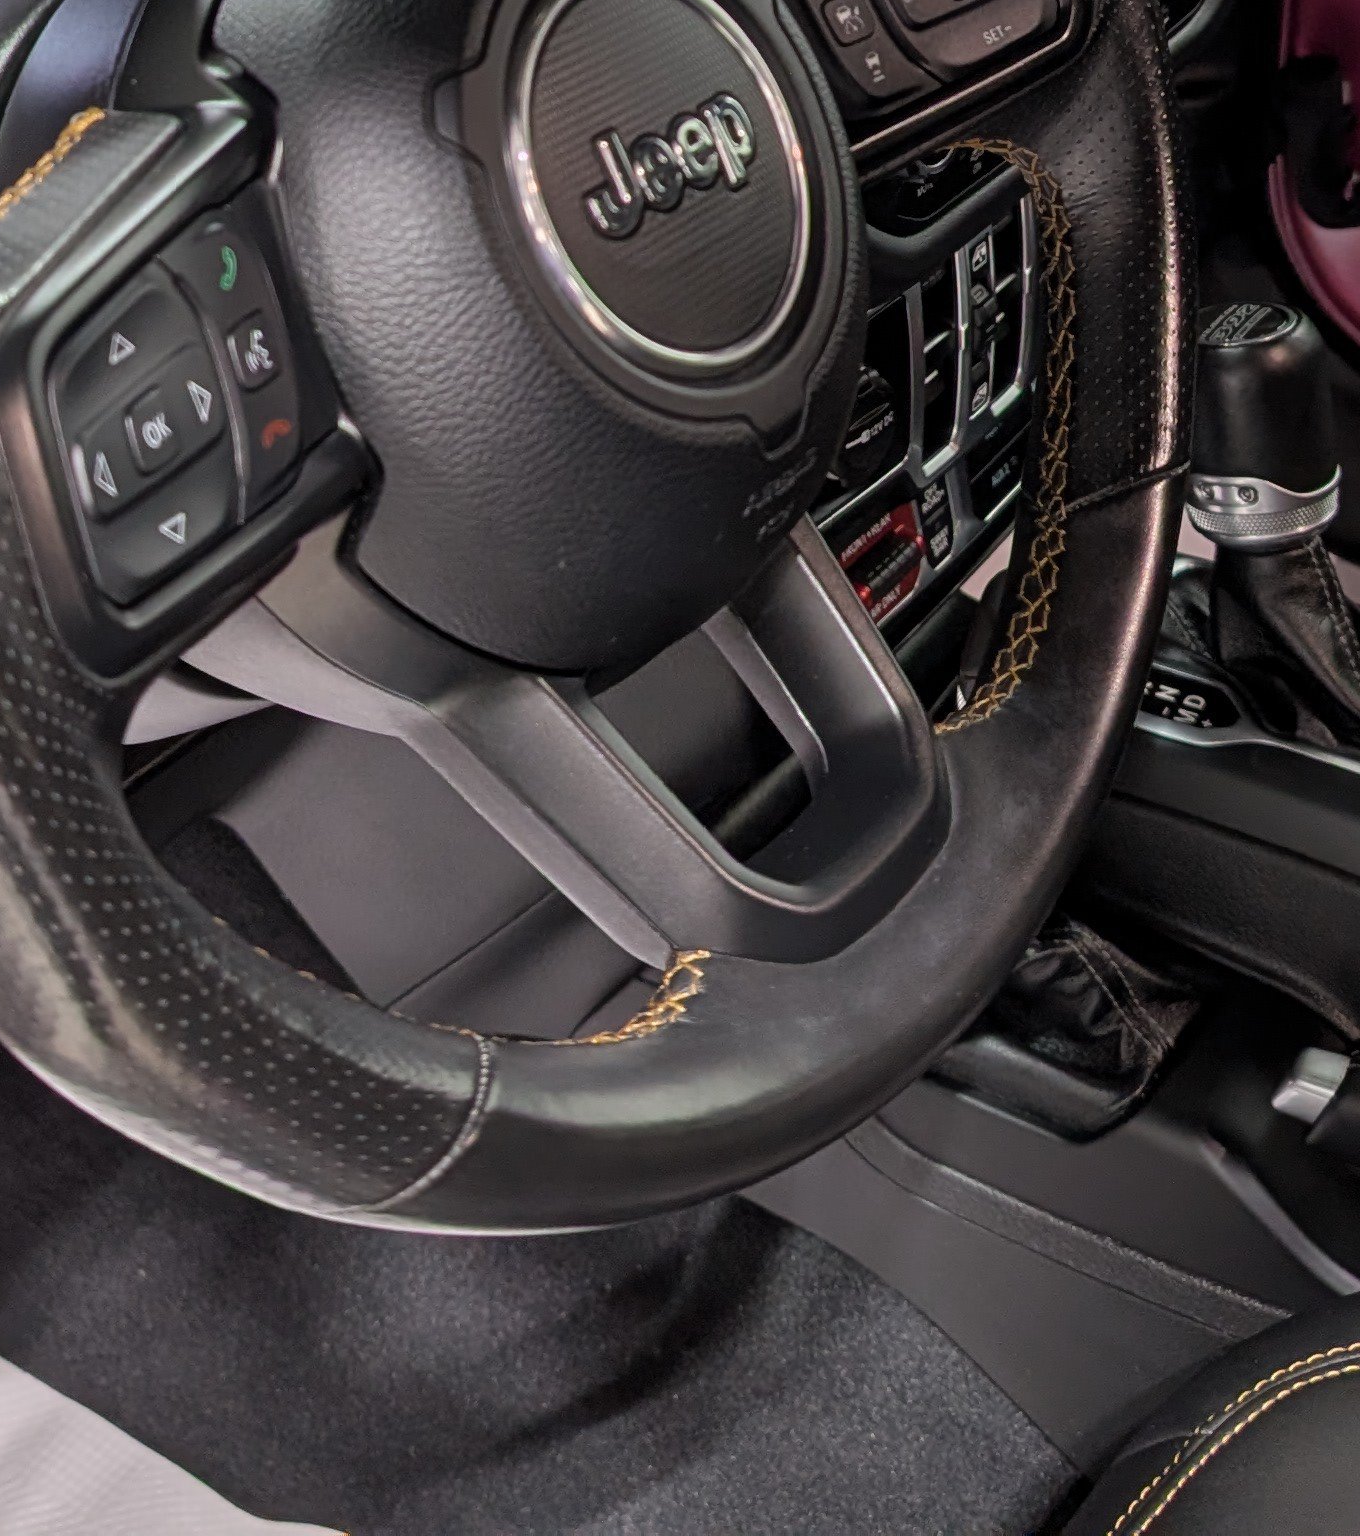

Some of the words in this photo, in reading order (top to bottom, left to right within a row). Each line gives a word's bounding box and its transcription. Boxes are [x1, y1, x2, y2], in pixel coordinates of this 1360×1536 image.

[586, 92, 754, 239] Jeep
[142, 412, 173, 449] OK
[1154, 684, 1181, 703] N
[1182, 694, 1207, 711] D
